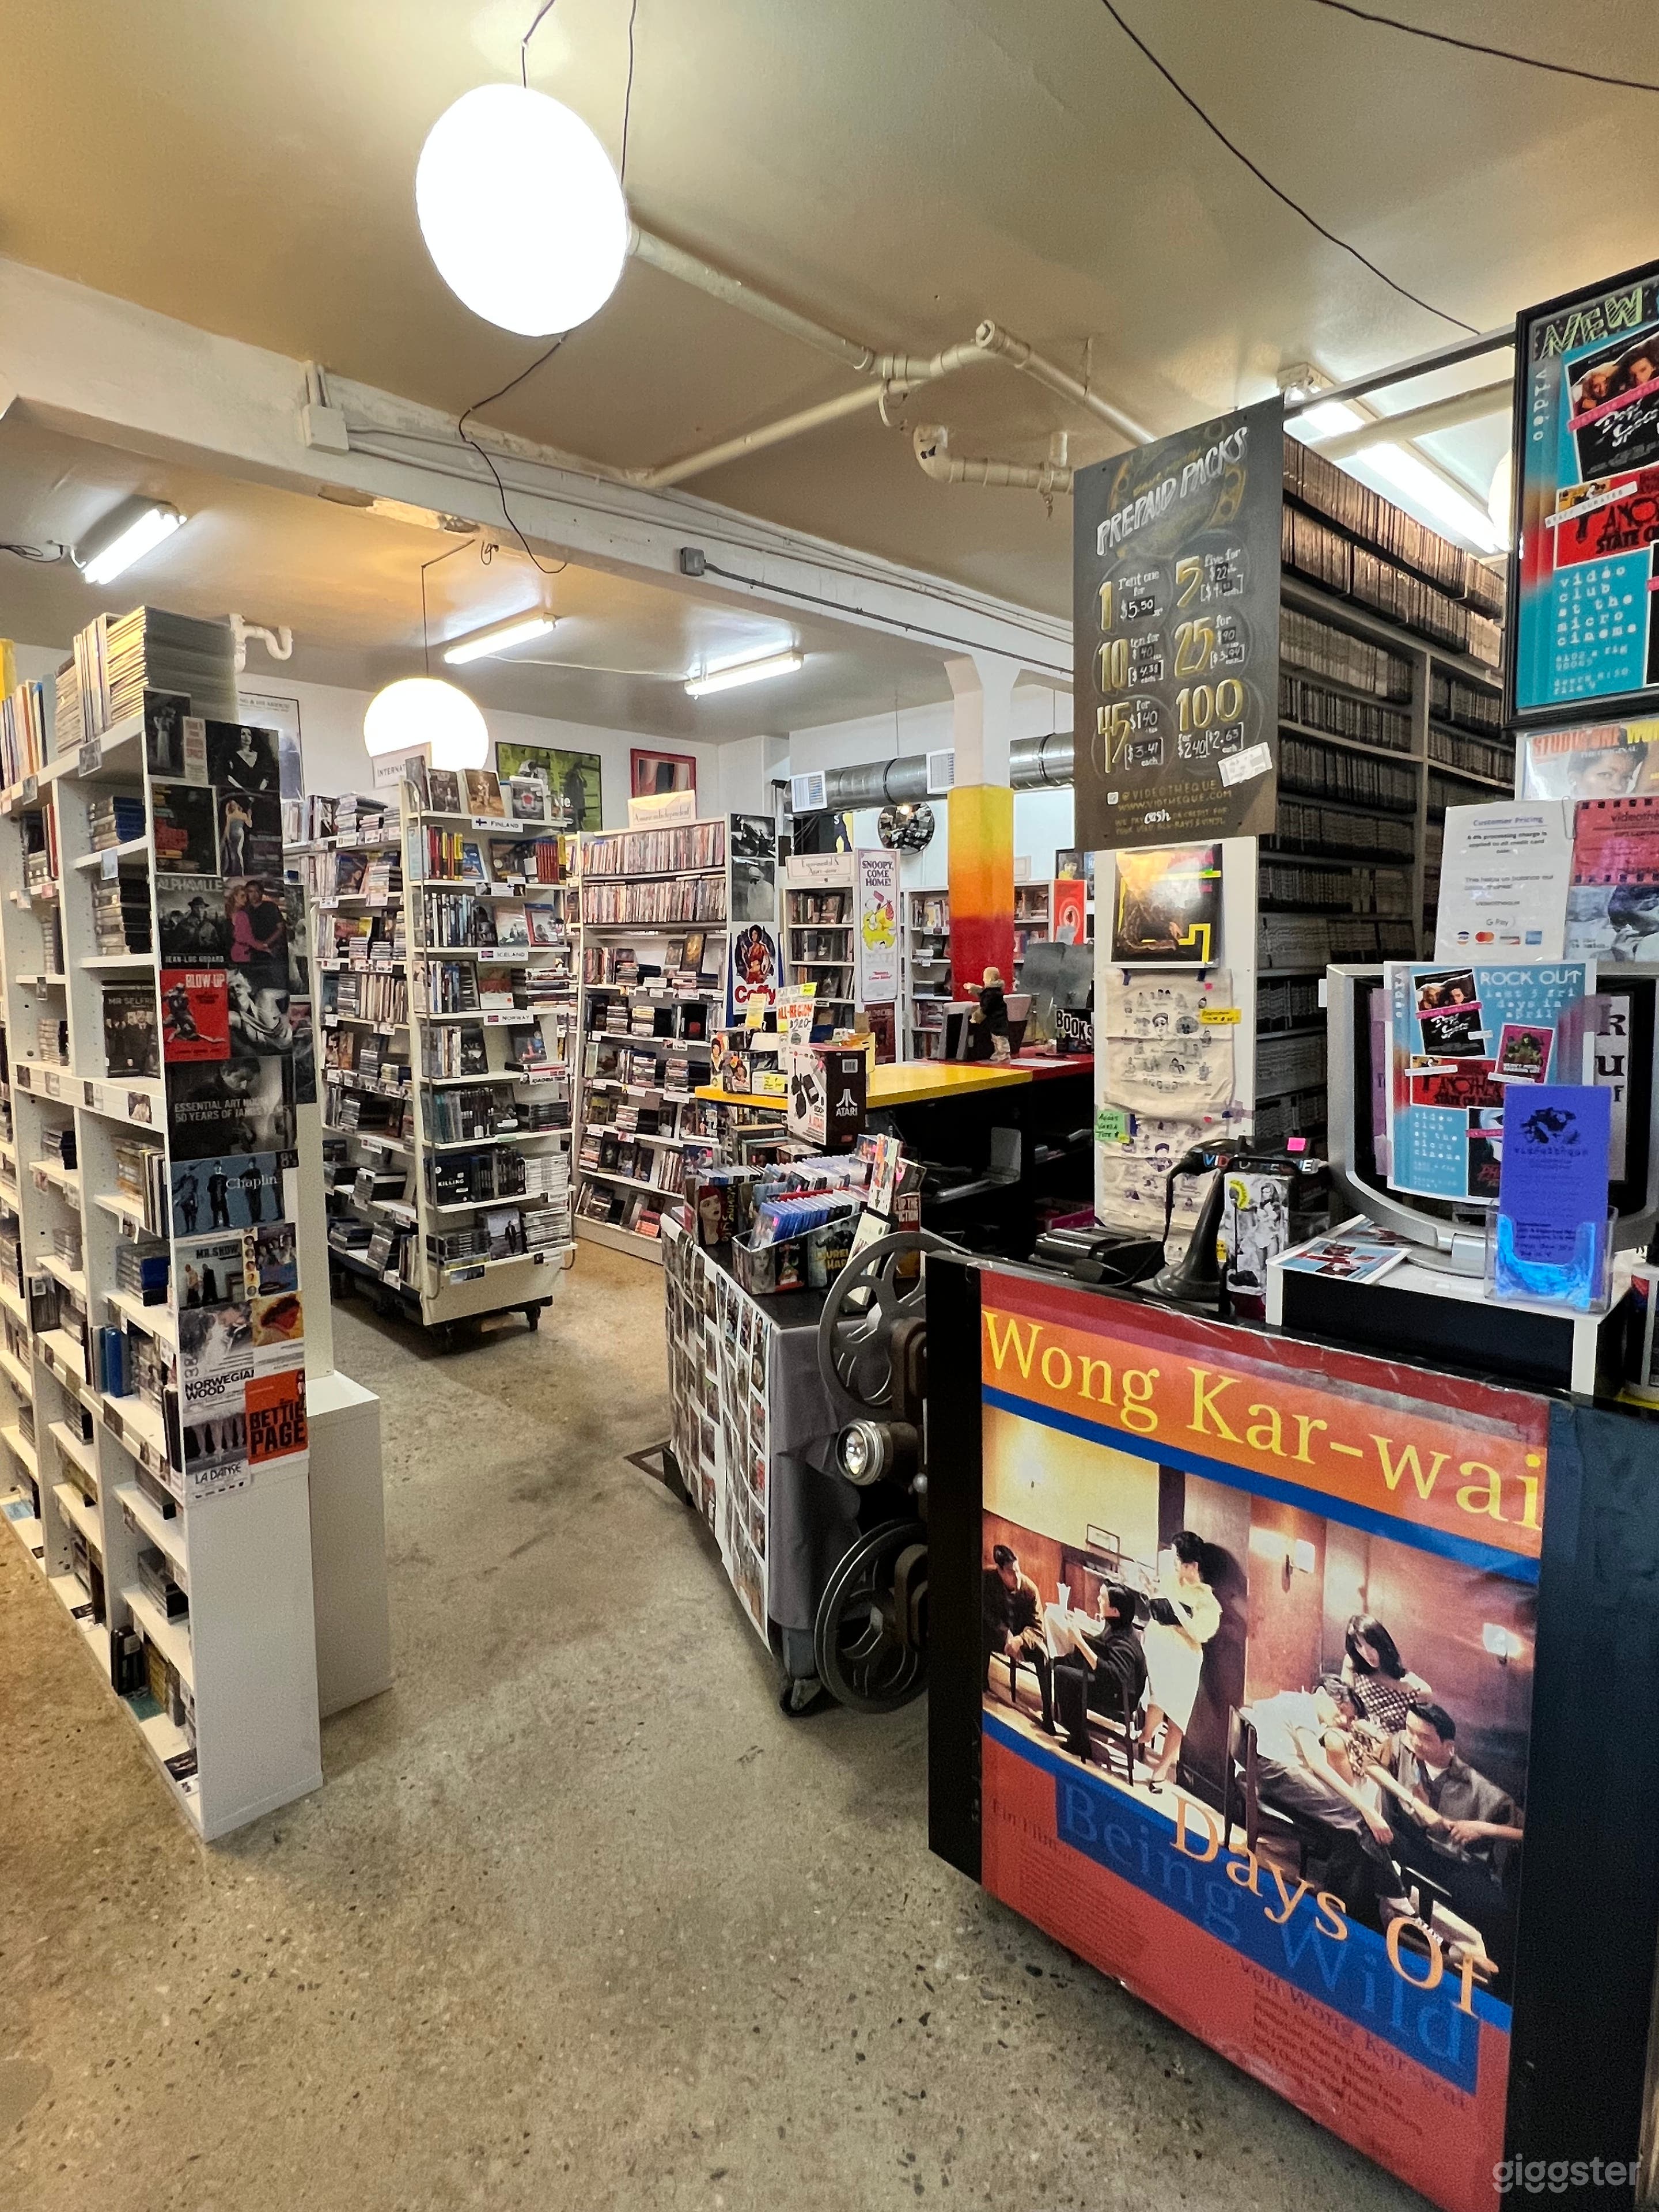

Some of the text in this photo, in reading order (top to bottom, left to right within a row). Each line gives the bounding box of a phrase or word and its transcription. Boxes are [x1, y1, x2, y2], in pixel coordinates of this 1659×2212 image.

[1539, 286, 1643, 359] NEW
[1097, 478, 1176, 555] PREPAID
[1180, 426, 1248, 498] PACKS
[1176, 555, 1203, 607] 5
[1559, 584, 1611, 603] club
[1099, 581, 1112, 631] 1
[1559, 593, 1633, 618] at the
[1215, 615, 1232, 628] for
[1558, 611, 1623, 632] micro
[1557, 623, 1637, 646] cinema
[1175, 616, 1214, 677] 25
[1099, 638, 1128, 693] 10
[1175, 679, 1244, 732] 100
[1096, 700, 1131, 774] 45
[377, 763, 406, 777] INTERNAT
[490, 820, 519, 829] FINLAND
[1144, 808, 1171, 824] cash
[1474, 819, 1512, 827] Customer
[862, 860, 894, 871] SNOOPY,
[867, 870, 889, 878] COME
[157, 878, 223, 892] ALPHAVILLE
[866, 878, 891, 887] HOME!
[185, 974, 225, 988] BLOW-UP
[1480, 969, 1582, 986] ROCK OUT
[1056, 1010, 1093, 1044] BOOKS
[175, 1101, 222, 1112] ESSENTIAL
[225, 1099, 241, 1108] ART
[836, 1107, 858, 1116] ATARI
[175, 1113, 188, 1123] 50
[189, 1109, 219, 1122] YEARS
[221, 1109, 233, 1119] OF
[226, 1173, 278, 1190] Chaplin
[438, 1179, 464, 1187] KILLING
[186, 1385, 225, 1401] WOOD
[249, 1401, 304, 1430] BETTIE
[981, 1310, 1547, 1531] Wong Kar-wai
[251, 1418, 305, 1456] PAGE
[195, 1462, 241, 1484] LA DANSE
[1170, 1795, 1349, 1941] Days
[1062, 1781, 1243, 1944] Being
[1278, 1920, 1463, 2067] Wild
